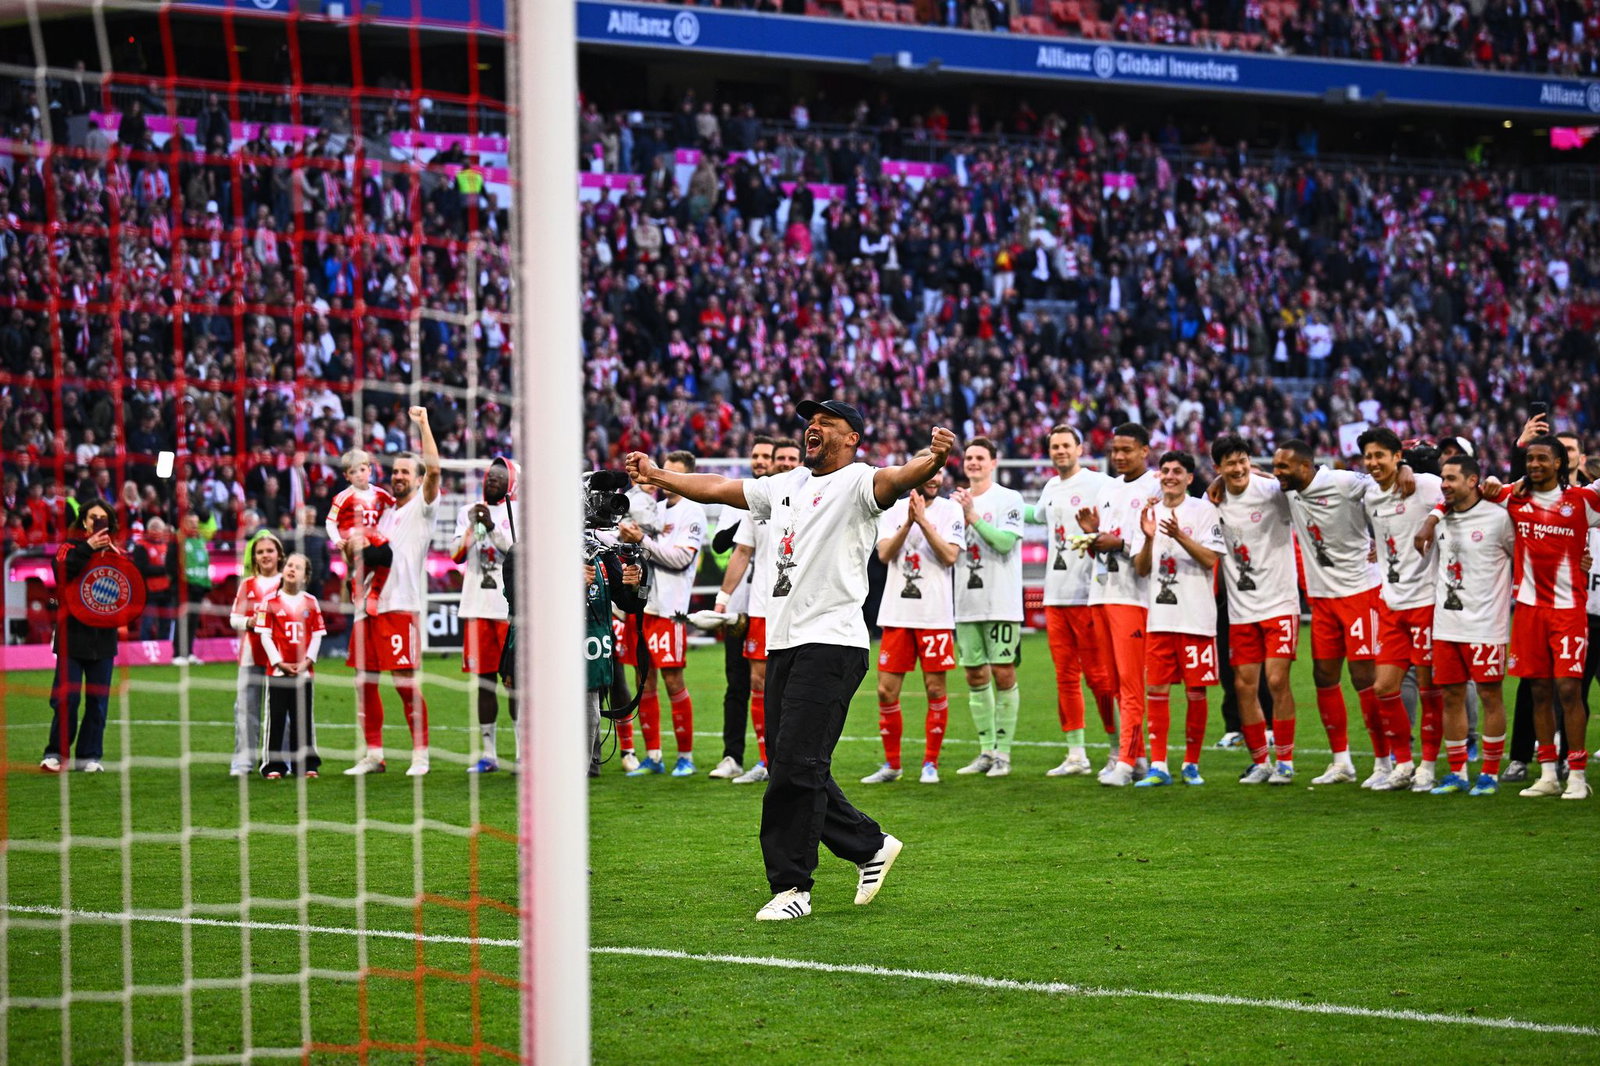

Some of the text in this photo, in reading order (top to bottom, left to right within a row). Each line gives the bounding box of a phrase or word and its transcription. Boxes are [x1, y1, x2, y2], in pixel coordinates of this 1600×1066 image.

[607, 9, 672, 38] Allianz
[1037, 46, 1240, 82] Allianz Global Investors
[1540, 83, 1586, 106] Allianz
[1533, 523, 1575, 537] MAGENTA
[1534, 531, 1546, 539] TV
[990, 623, 1013, 644] 40
[1278, 619, 1292, 642] 3
[1350, 617, 1364, 640] 4
[391, 634, 404, 656] 9
[648, 631, 671, 654] 44
[922, 633, 949, 658] 27
[1559, 635, 1586, 660] 17
[1184, 644, 1215, 669] 34
[1469, 643, 1500, 666] 22
